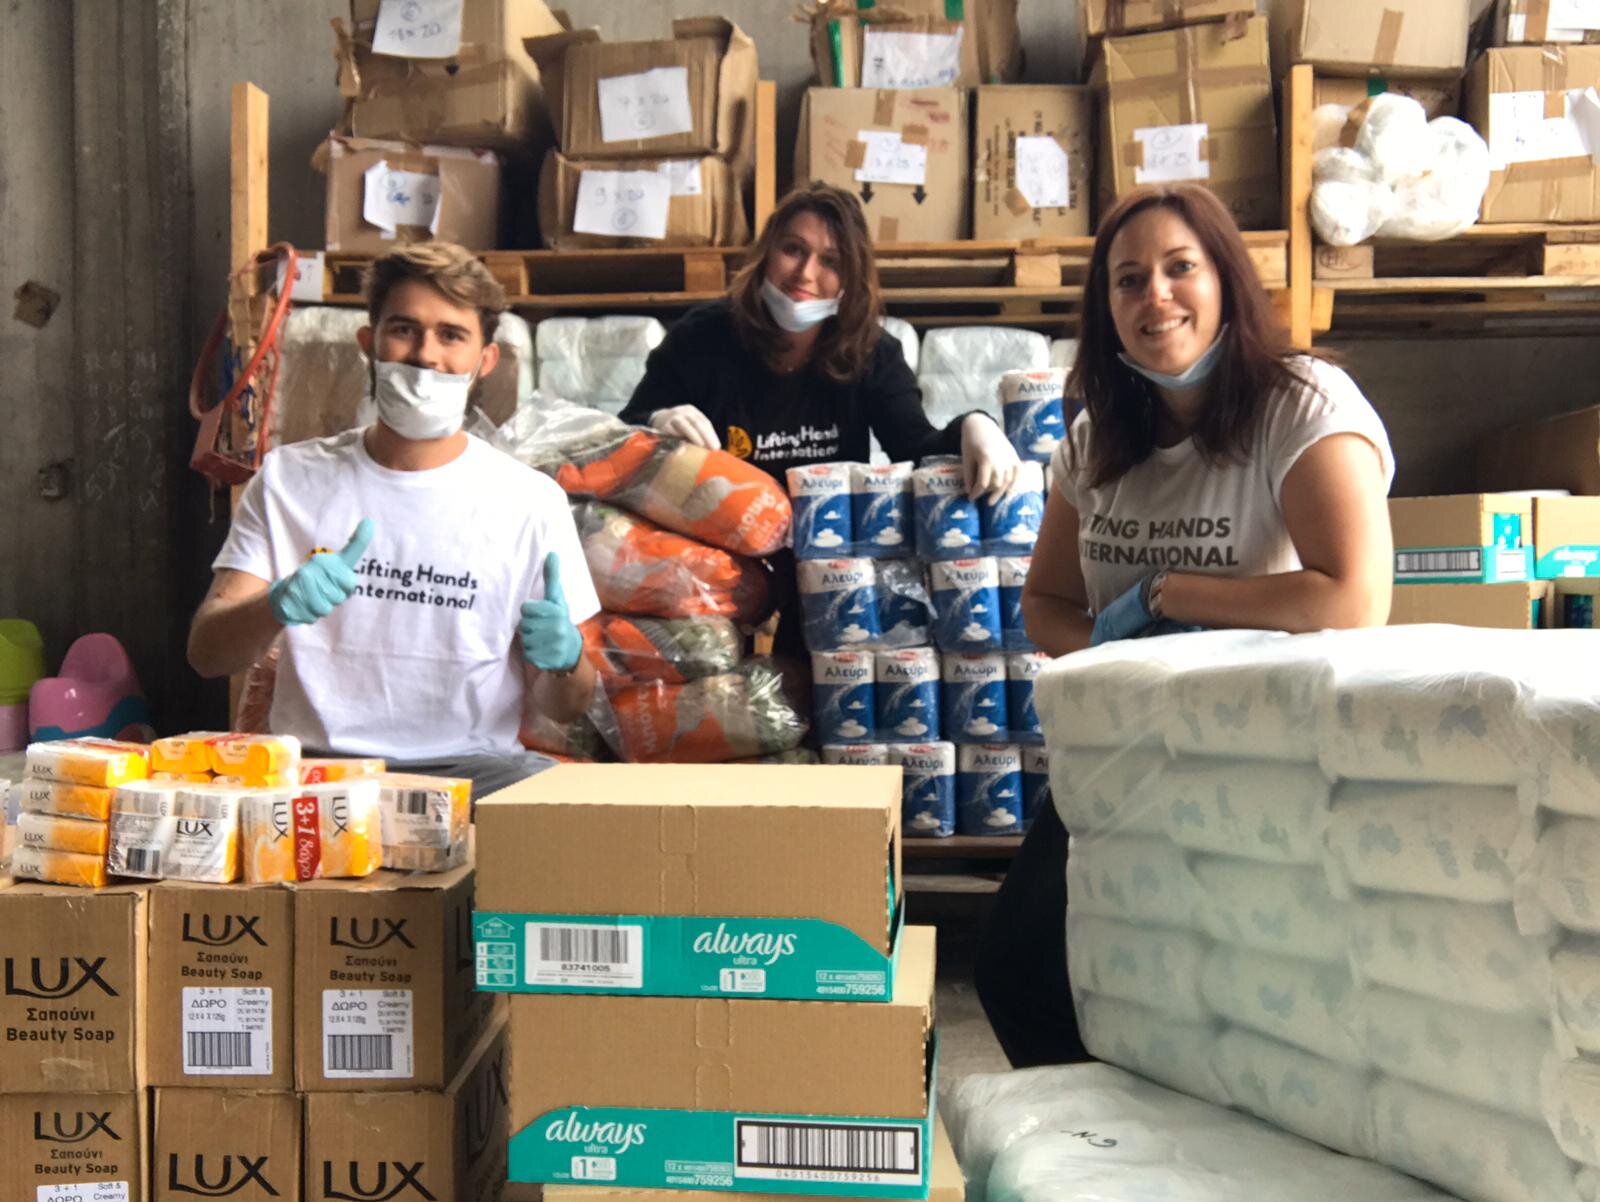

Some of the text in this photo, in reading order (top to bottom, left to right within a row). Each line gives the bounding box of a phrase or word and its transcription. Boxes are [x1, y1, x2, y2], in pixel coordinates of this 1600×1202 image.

[1149, 517, 1231, 540] HANDS
[416, 564, 478, 589] Hands
[353, 584, 475, 610] nternational
[32, 765, 54, 776] LUX
[30, 790, 51, 801] LUX
[272, 801, 289, 843] LUX
[332, 796, 348, 838] LUX
[176, 820, 213, 837] LUX
[24, 832, 44, 843] LUX
[20, 863, 41, 874] LUX
[183, 913, 269, 947] LUX
[330, 917, 416, 949] LUX
[693, 922, 798, 966] always
[196, 951, 248, 964] Σαπούνι
[345, 955, 398, 968] Σαπούνι
[5, 957, 119, 999] LUX
[181, 966, 263, 981] Beauty Soap
[330, 970, 412, 985] Beauty Soap
[191, 999, 227, 1009] ΔΩΡΟ
[331, 1001, 367, 1011] ΔΩΡΟ
[26, 1007, 95, 1022] Σαπούνι
[6, 1027, 115, 1044] Beauty Soap
[34, 1111, 122, 1143] LUX
[545, 1111, 648, 1154] always
[50, 1147, 103, 1160] Σαπούνι
[35, 1163, 118, 1176] Beauty Soap
[169, 1153, 280, 1197] LUX
[323, 1161, 438, 1202] LUX
